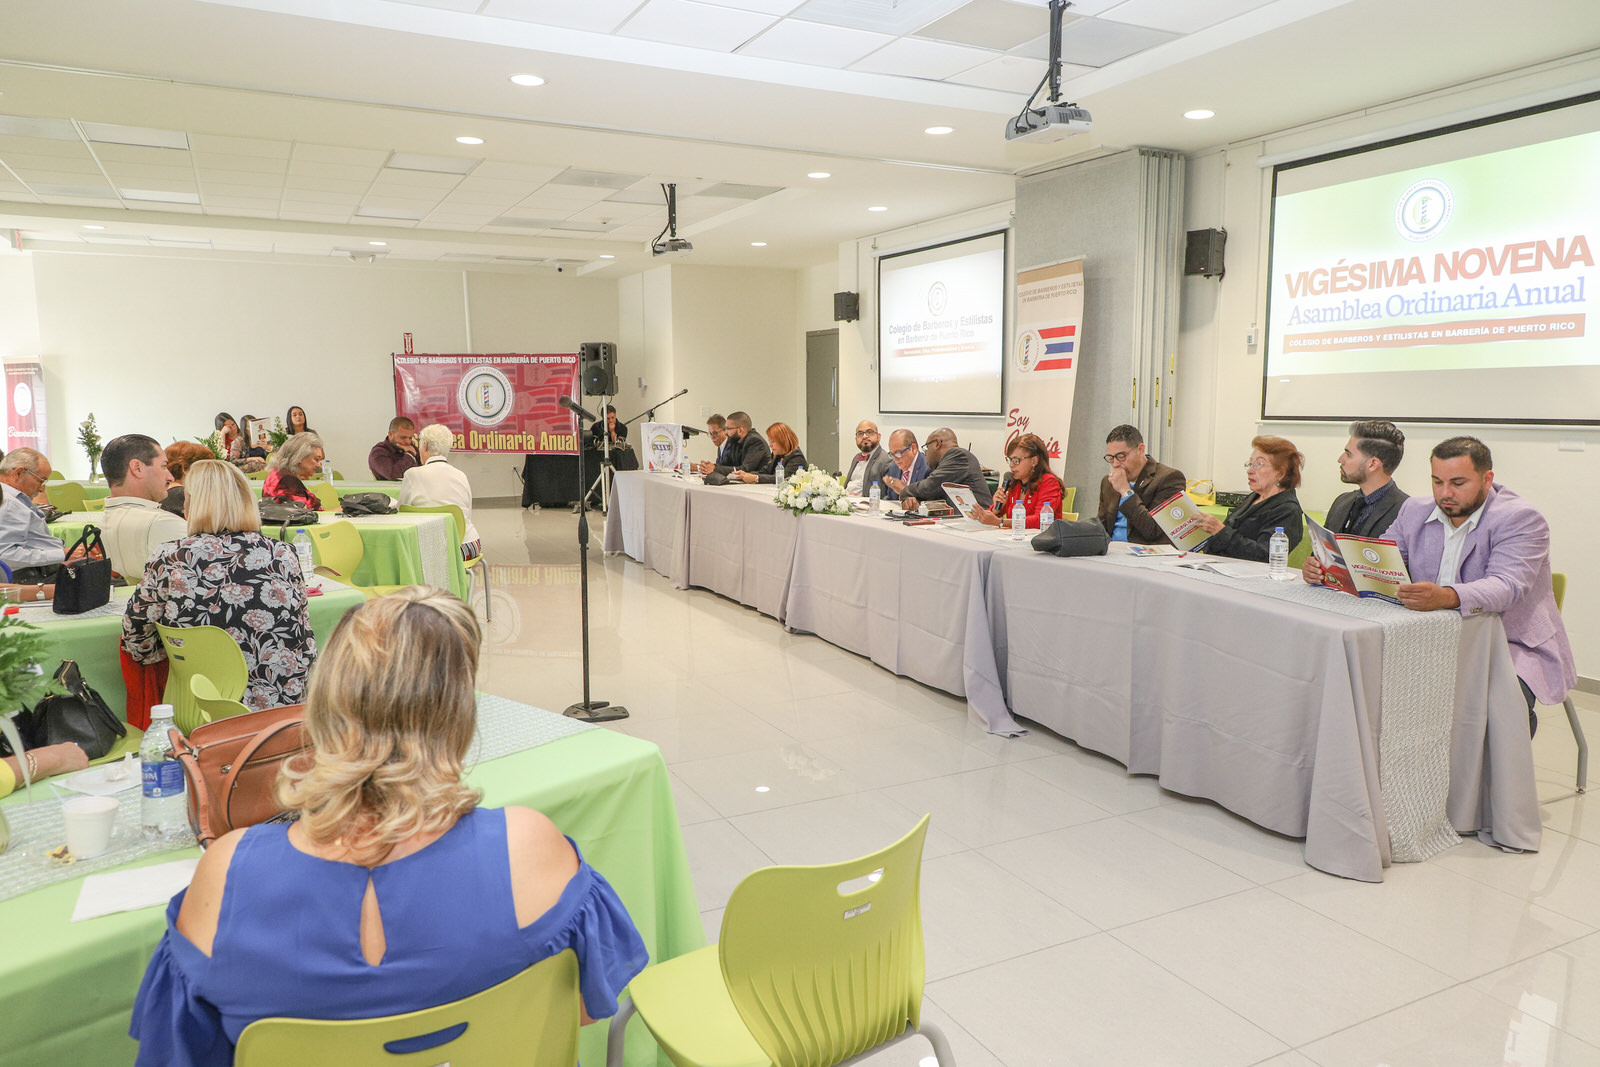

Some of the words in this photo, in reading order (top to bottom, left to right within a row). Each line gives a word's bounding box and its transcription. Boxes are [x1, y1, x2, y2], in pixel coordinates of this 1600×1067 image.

[1285, 258, 1426, 298] VIGÉSIMA
[1434, 235, 1595, 282] NOVENA
[1287, 298, 1382, 326] Asamblea
[1386, 285, 1498, 318] Ordinaria
[1500, 276, 1586, 308] Anual
[889, 322, 912, 335] Colegio
[913, 322, 921, 331] de
[923, 319, 952, 331] Barberos
[954, 320, 958, 329] y
[960, 314, 993, 326] Estilistas
[1289, 338, 1320, 346] COLEGIO
[1334, 335, 1374, 344] BARBEROS
[1383, 332, 1428, 341] ESTILISTAS
[1445, 326, 1489, 337] BARBERÍA
[1508, 323, 1546, 333] PUERTO
[1550, 322, 1575, 331] RICO
[502, 355, 529, 363] BARBERÍA
[1007, 408, 1030, 432] Soy
[469, 430, 535, 450] Ordinaria
[539, 431, 578, 451] Anual
